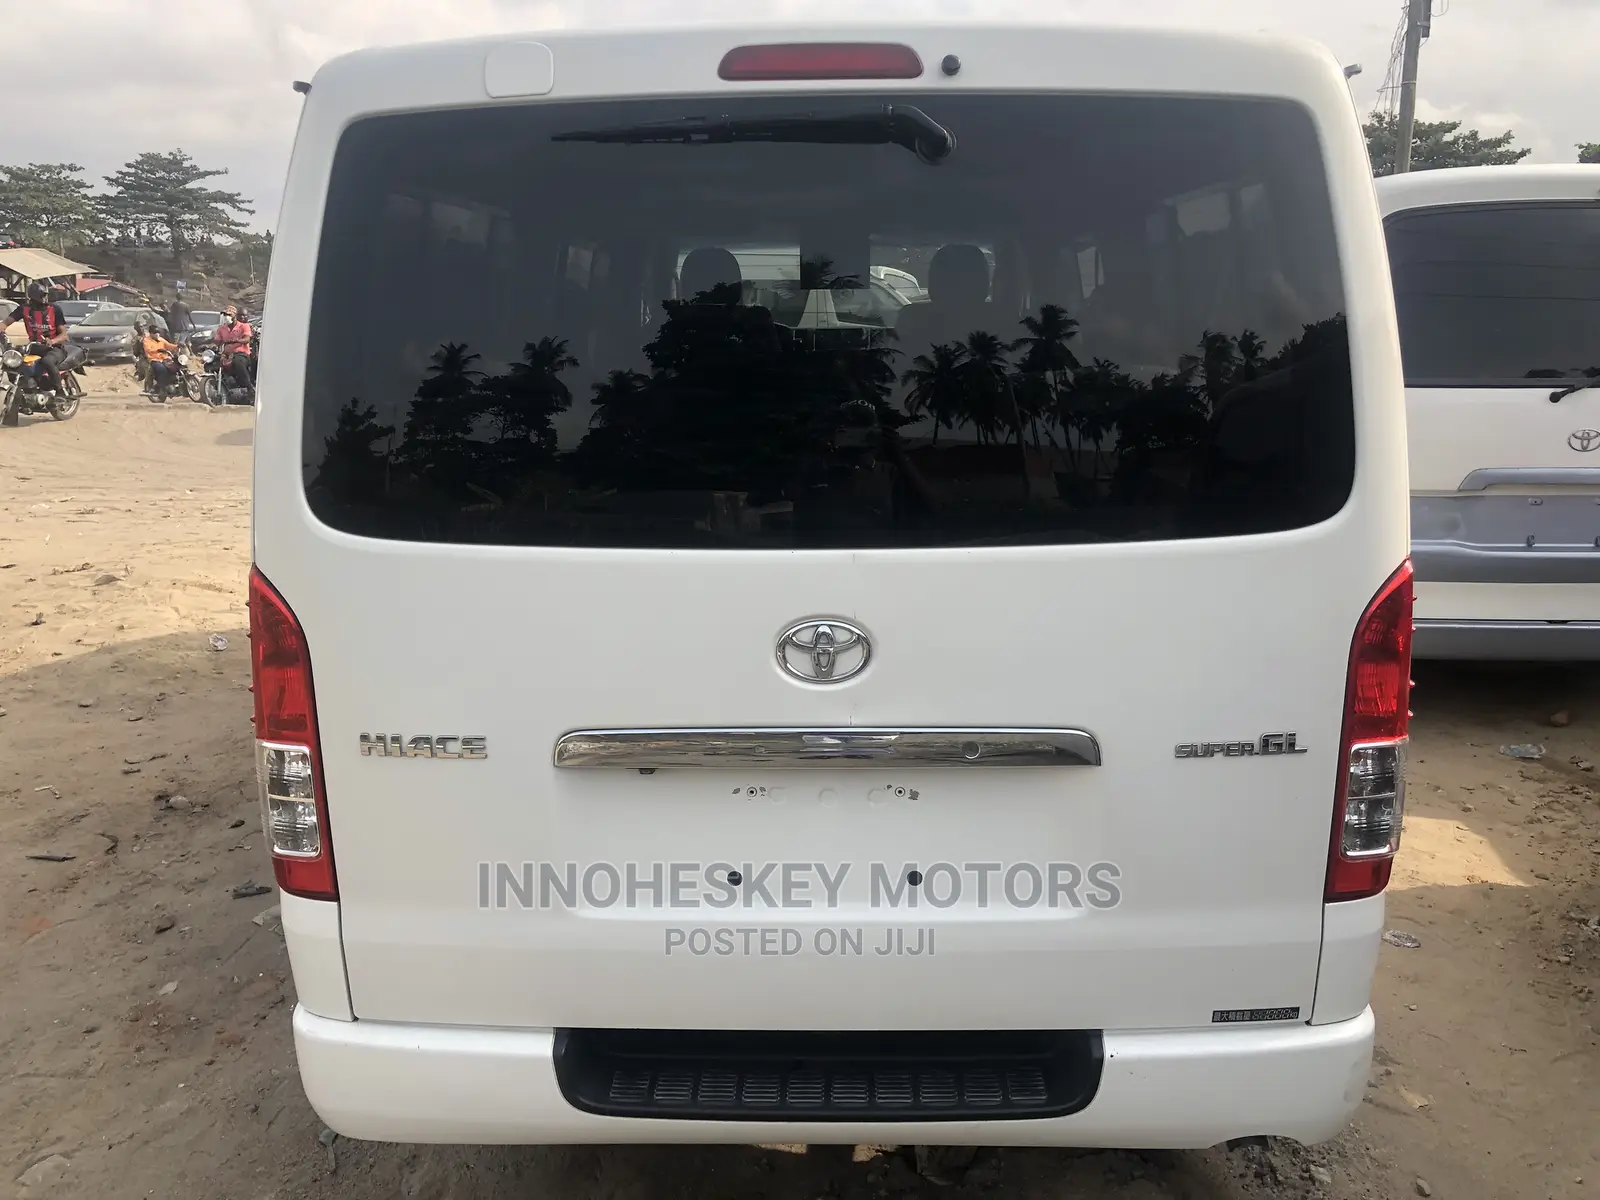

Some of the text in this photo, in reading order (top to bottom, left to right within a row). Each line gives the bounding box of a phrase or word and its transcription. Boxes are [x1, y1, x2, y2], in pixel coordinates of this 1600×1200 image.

[359, 732, 487, 759] HIACE
[1175, 731, 1308, 758] SUPER GL
